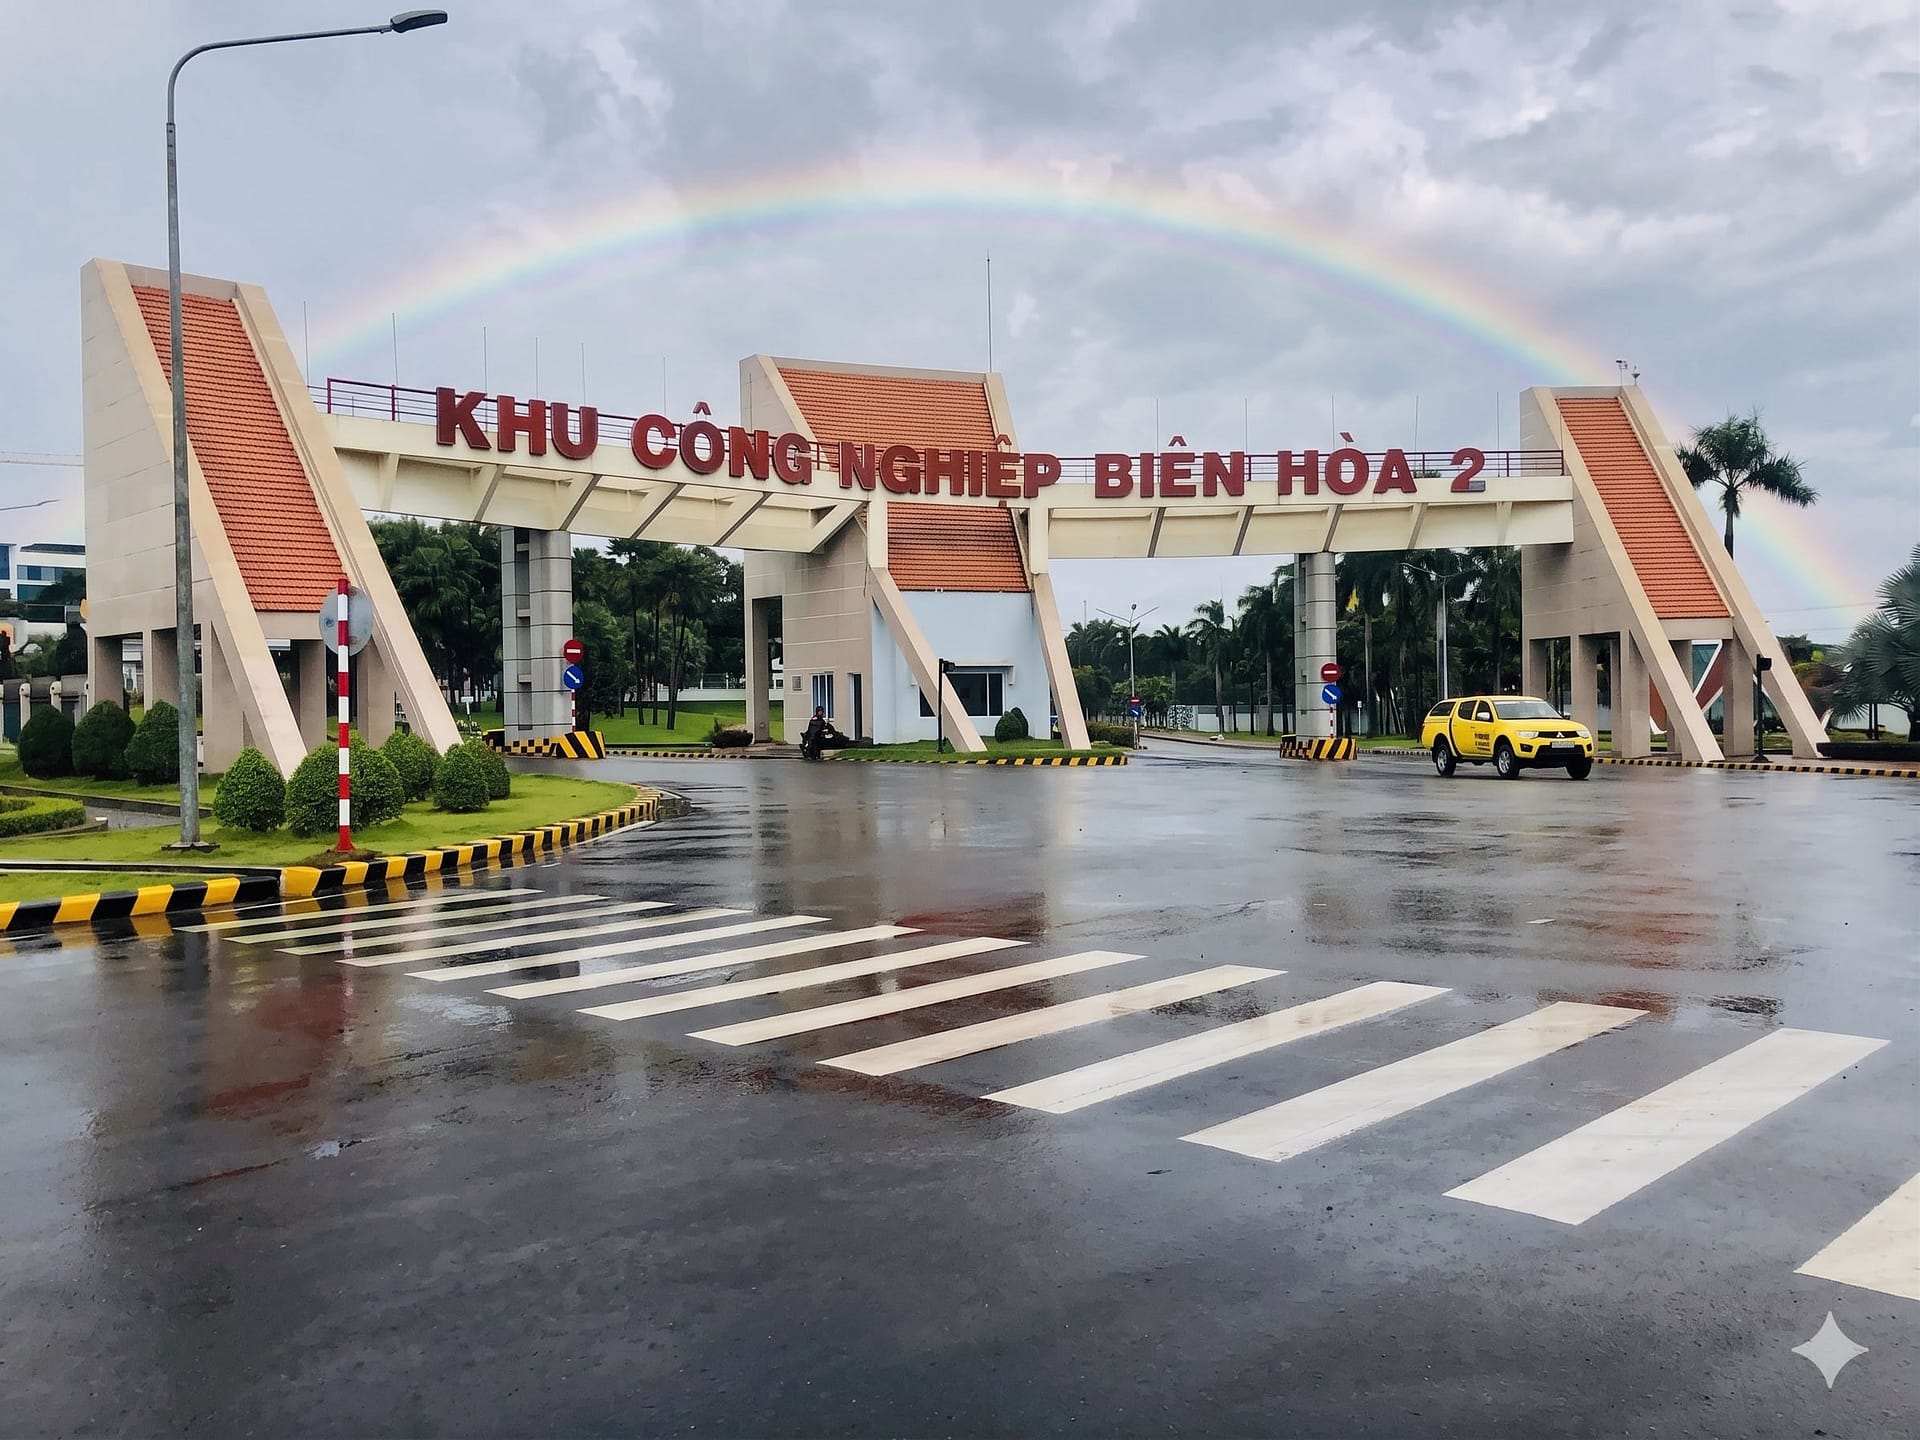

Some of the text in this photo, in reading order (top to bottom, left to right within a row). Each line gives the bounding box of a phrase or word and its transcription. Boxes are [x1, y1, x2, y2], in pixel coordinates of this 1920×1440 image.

[436, 387, 598, 459] KHU
[631, 401, 812, 485] CÔNG
[1095, 435, 1245, 498] BIÊN
[1277, 432, 1417, 495] HÒA
[1450, 448, 1486, 492] 2
